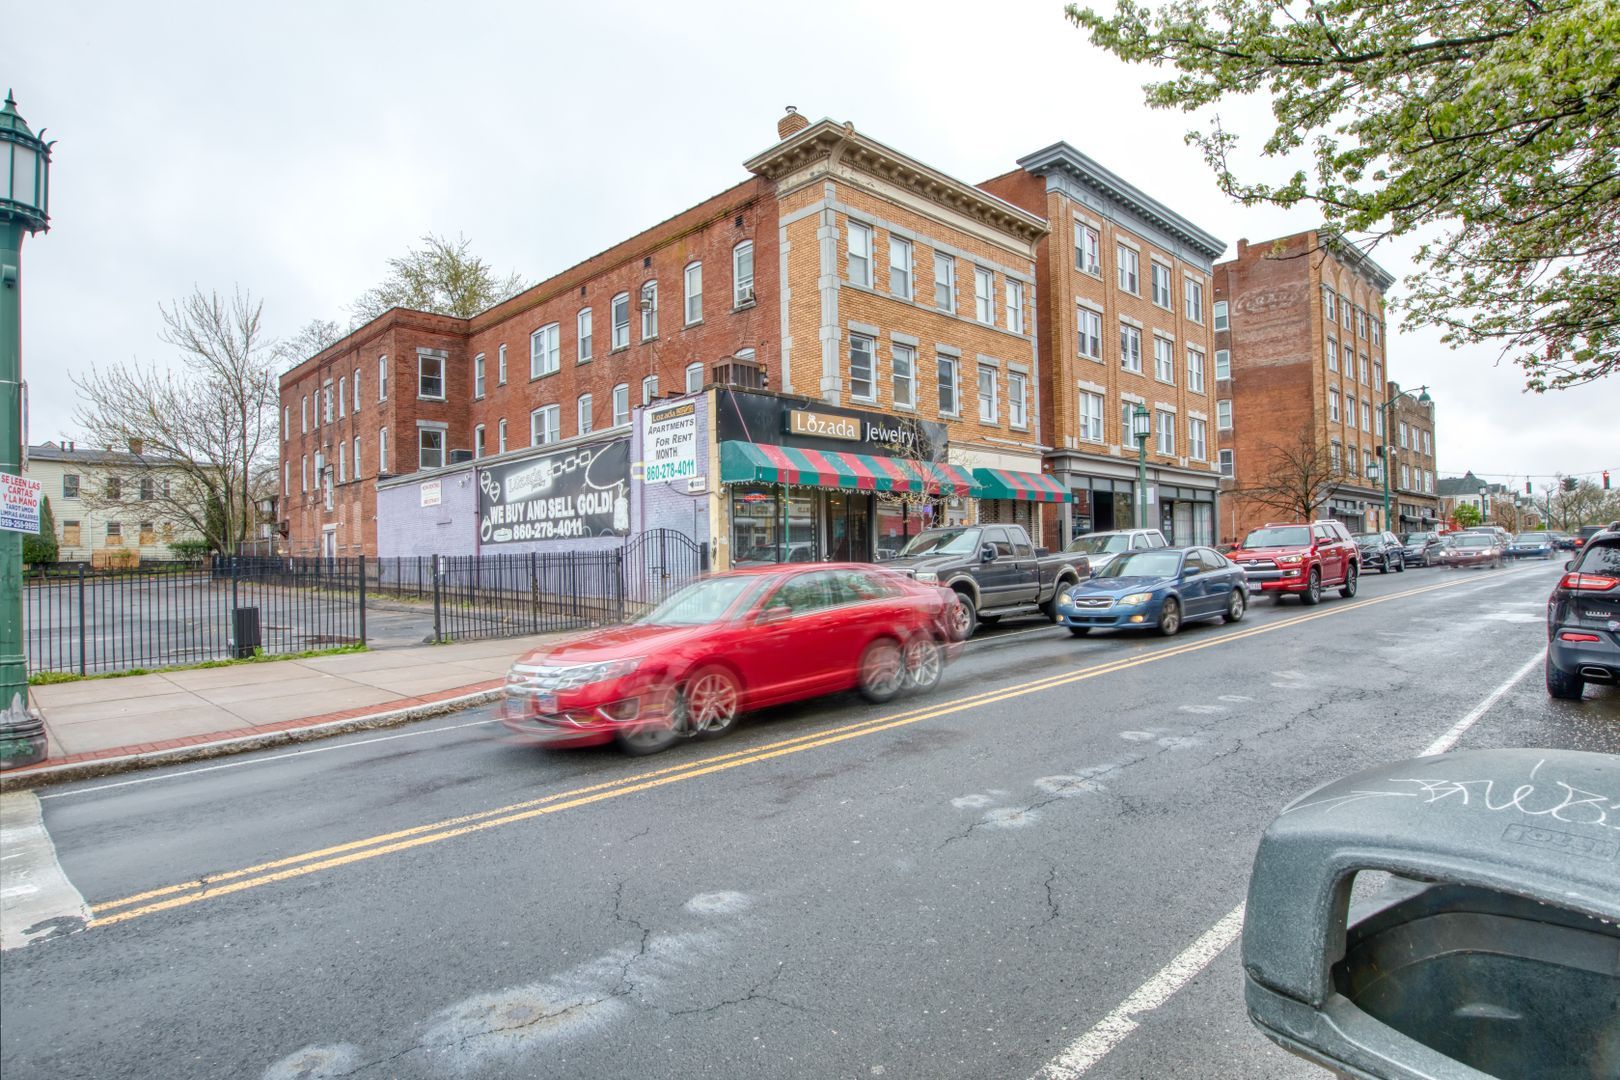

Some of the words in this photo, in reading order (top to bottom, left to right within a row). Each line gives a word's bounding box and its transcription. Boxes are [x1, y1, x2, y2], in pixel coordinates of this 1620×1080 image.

[648, 418, 695, 435] APARTMENTS
[797, 413, 855, 437] Lozada
[866, 421, 915, 448] Jewelry
[655, 437, 670, 448] FOR
[672, 433, 693, 444] RENT
[655, 446, 678, 460] MONTH
[646, 459, 695, 481] 860-278-4011
[1, 474, 10, 483] SE
[11, 477, 27, 487] LEEN
[28, 480, 40, 490] LAS
[8, 485, 33, 497] CARTAS
[3, 493, 8, 502] Y
[9, 495, 17, 503] LA
[18, 497, 37, 507] MANO
[490, 505, 505, 525] WE
[505, 502, 525, 523] BUY
[526, 500, 547, 521] AND
[548, 495, 575, 519] SELL
[513, 518, 583, 540] 860-278-4011
